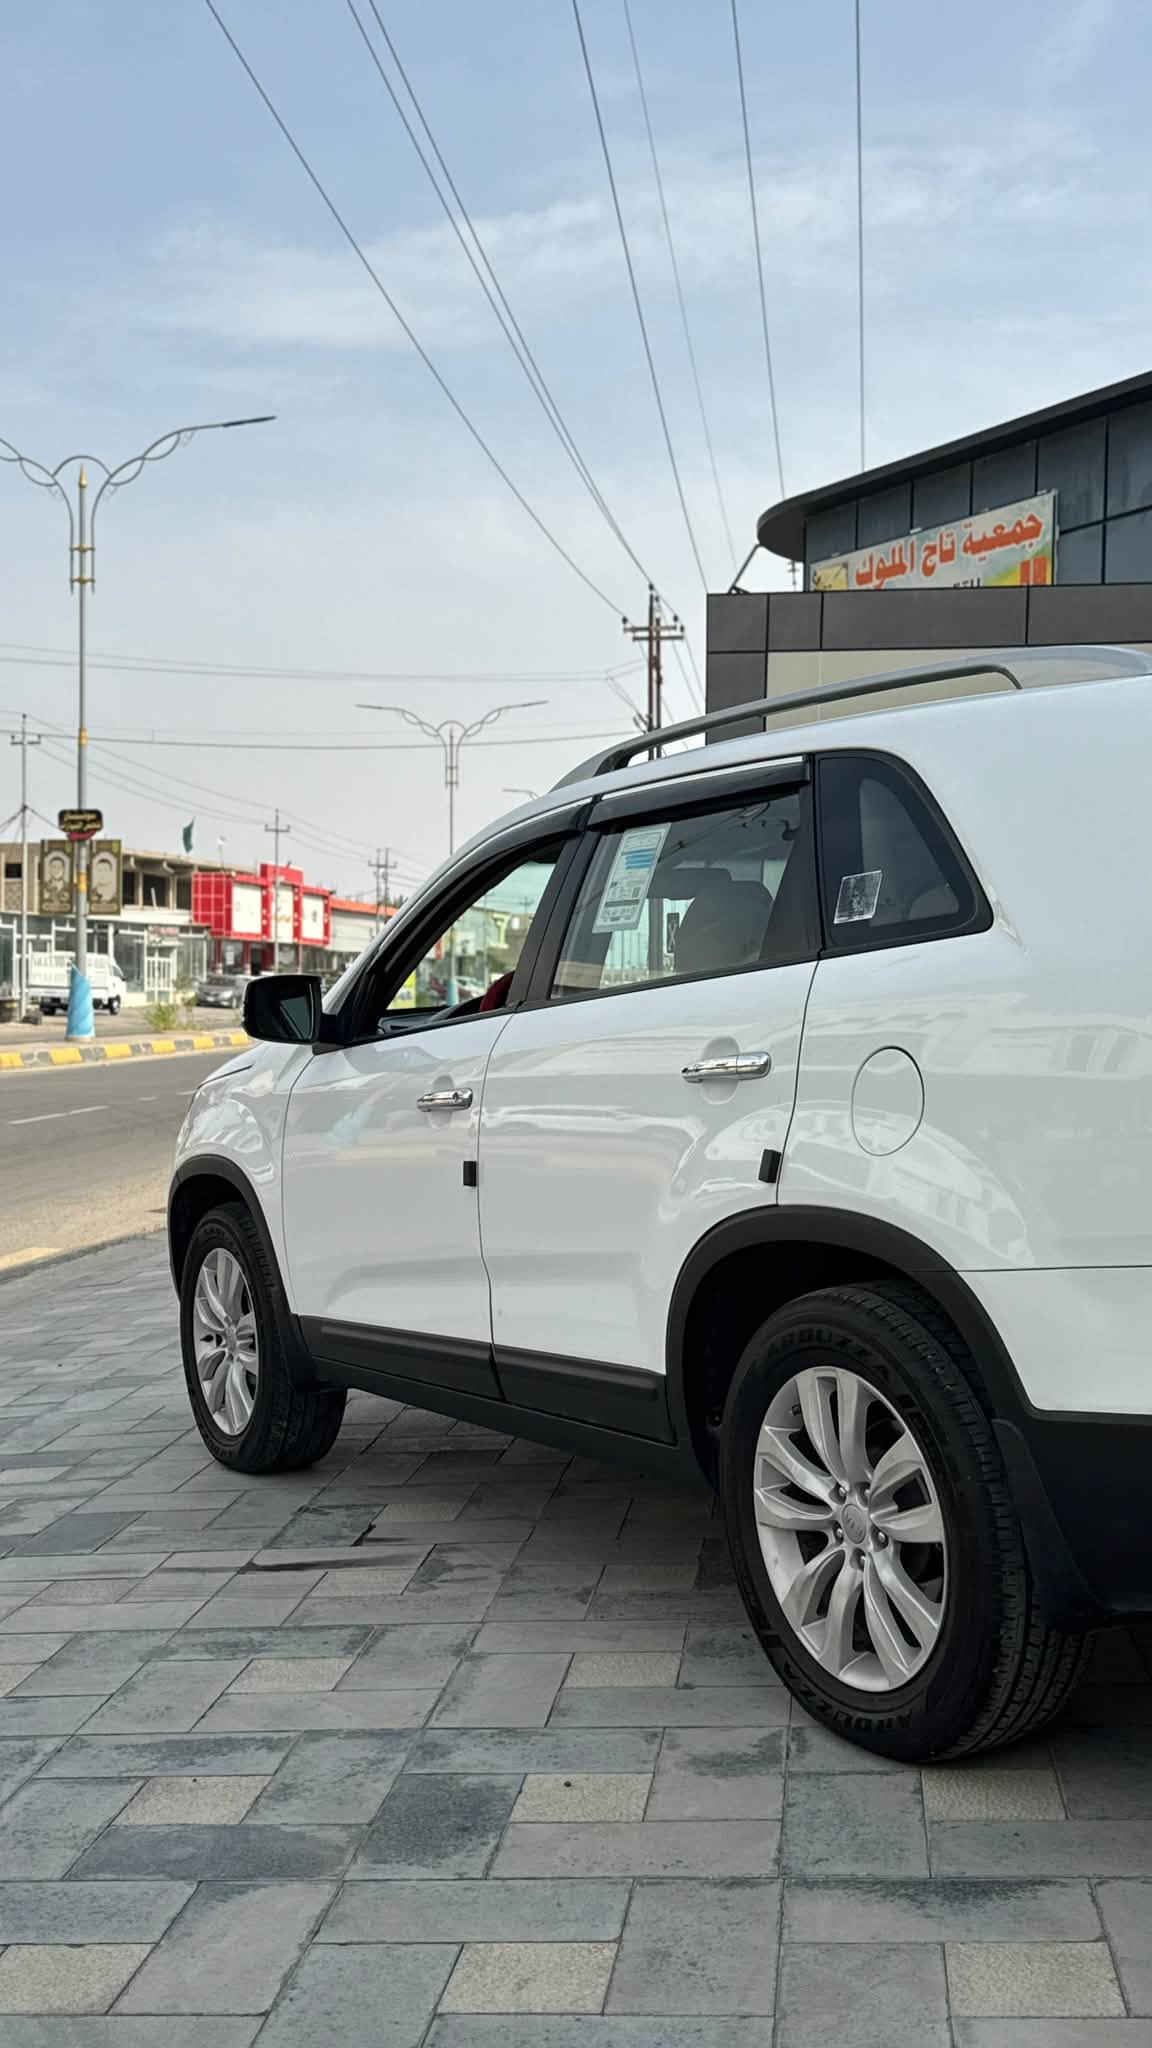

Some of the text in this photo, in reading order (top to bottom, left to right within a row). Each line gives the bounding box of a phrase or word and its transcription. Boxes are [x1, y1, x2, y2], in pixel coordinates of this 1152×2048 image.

[921, 531, 955, 577] تاج
[963, 512, 1043, 560] جمعية
[855, 542, 915, 590] الملوك
